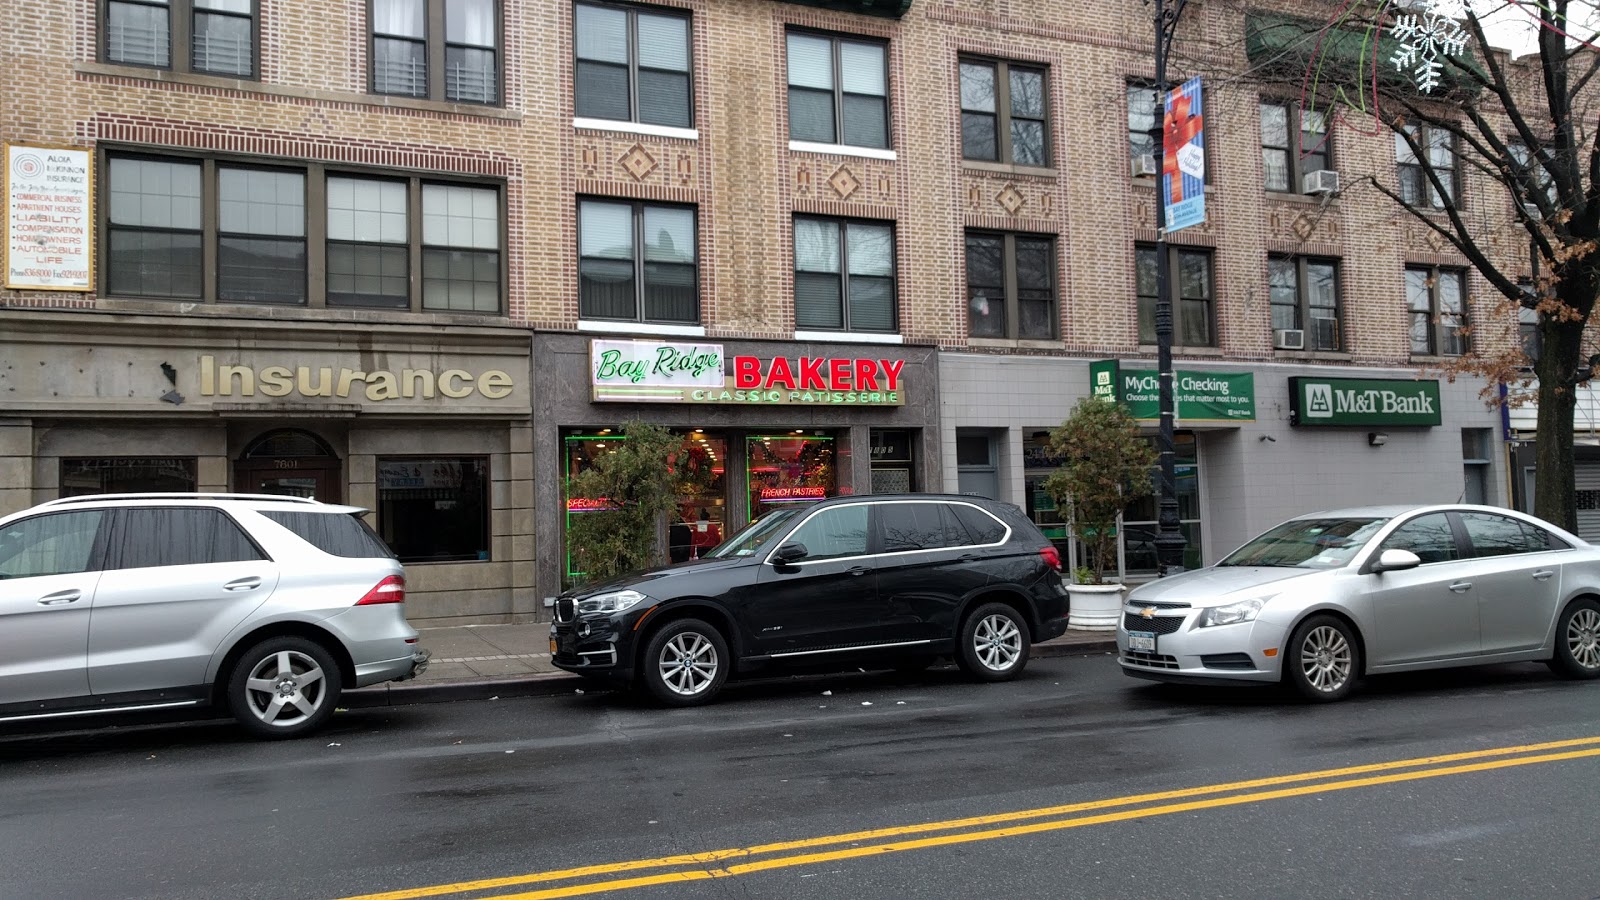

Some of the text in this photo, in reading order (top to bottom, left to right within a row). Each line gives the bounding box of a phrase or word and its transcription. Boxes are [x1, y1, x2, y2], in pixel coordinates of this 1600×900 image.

[16, 193, 82, 204] COMMERCIAL BUSINESS
[16, 203, 82, 214] APARTMENT HOUSES
[16, 214, 81, 224] LIABILITY
[16, 224, 83, 235] COMPENSATION
[16, 234, 82, 245] HOMOWNERS
[16, 245, 82, 255] AUTOMOBILE
[36, 256, 63, 264] LIFE
[597, 346, 720, 384] Bay Ridge
[201, 355, 514, 401] Insurance
[733, 356, 905, 391] BAKERY
[1181, 377, 1230, 395] Checking
[691, 389, 898, 403] CLASSIC PATISSERIE
[1126, 393, 1149, 402] Choose
[1183, 394, 1196, 402] that
[1196, 395, 1215, 403] matter
[1216, 395, 1230, 403] most
[1230, 395, 1237, 403] to
[1334, 389, 1435, 414] M&T Bank
[274, 459, 298, 469] 7801
[761, 486, 825, 497] FRENCH PASTRIES
